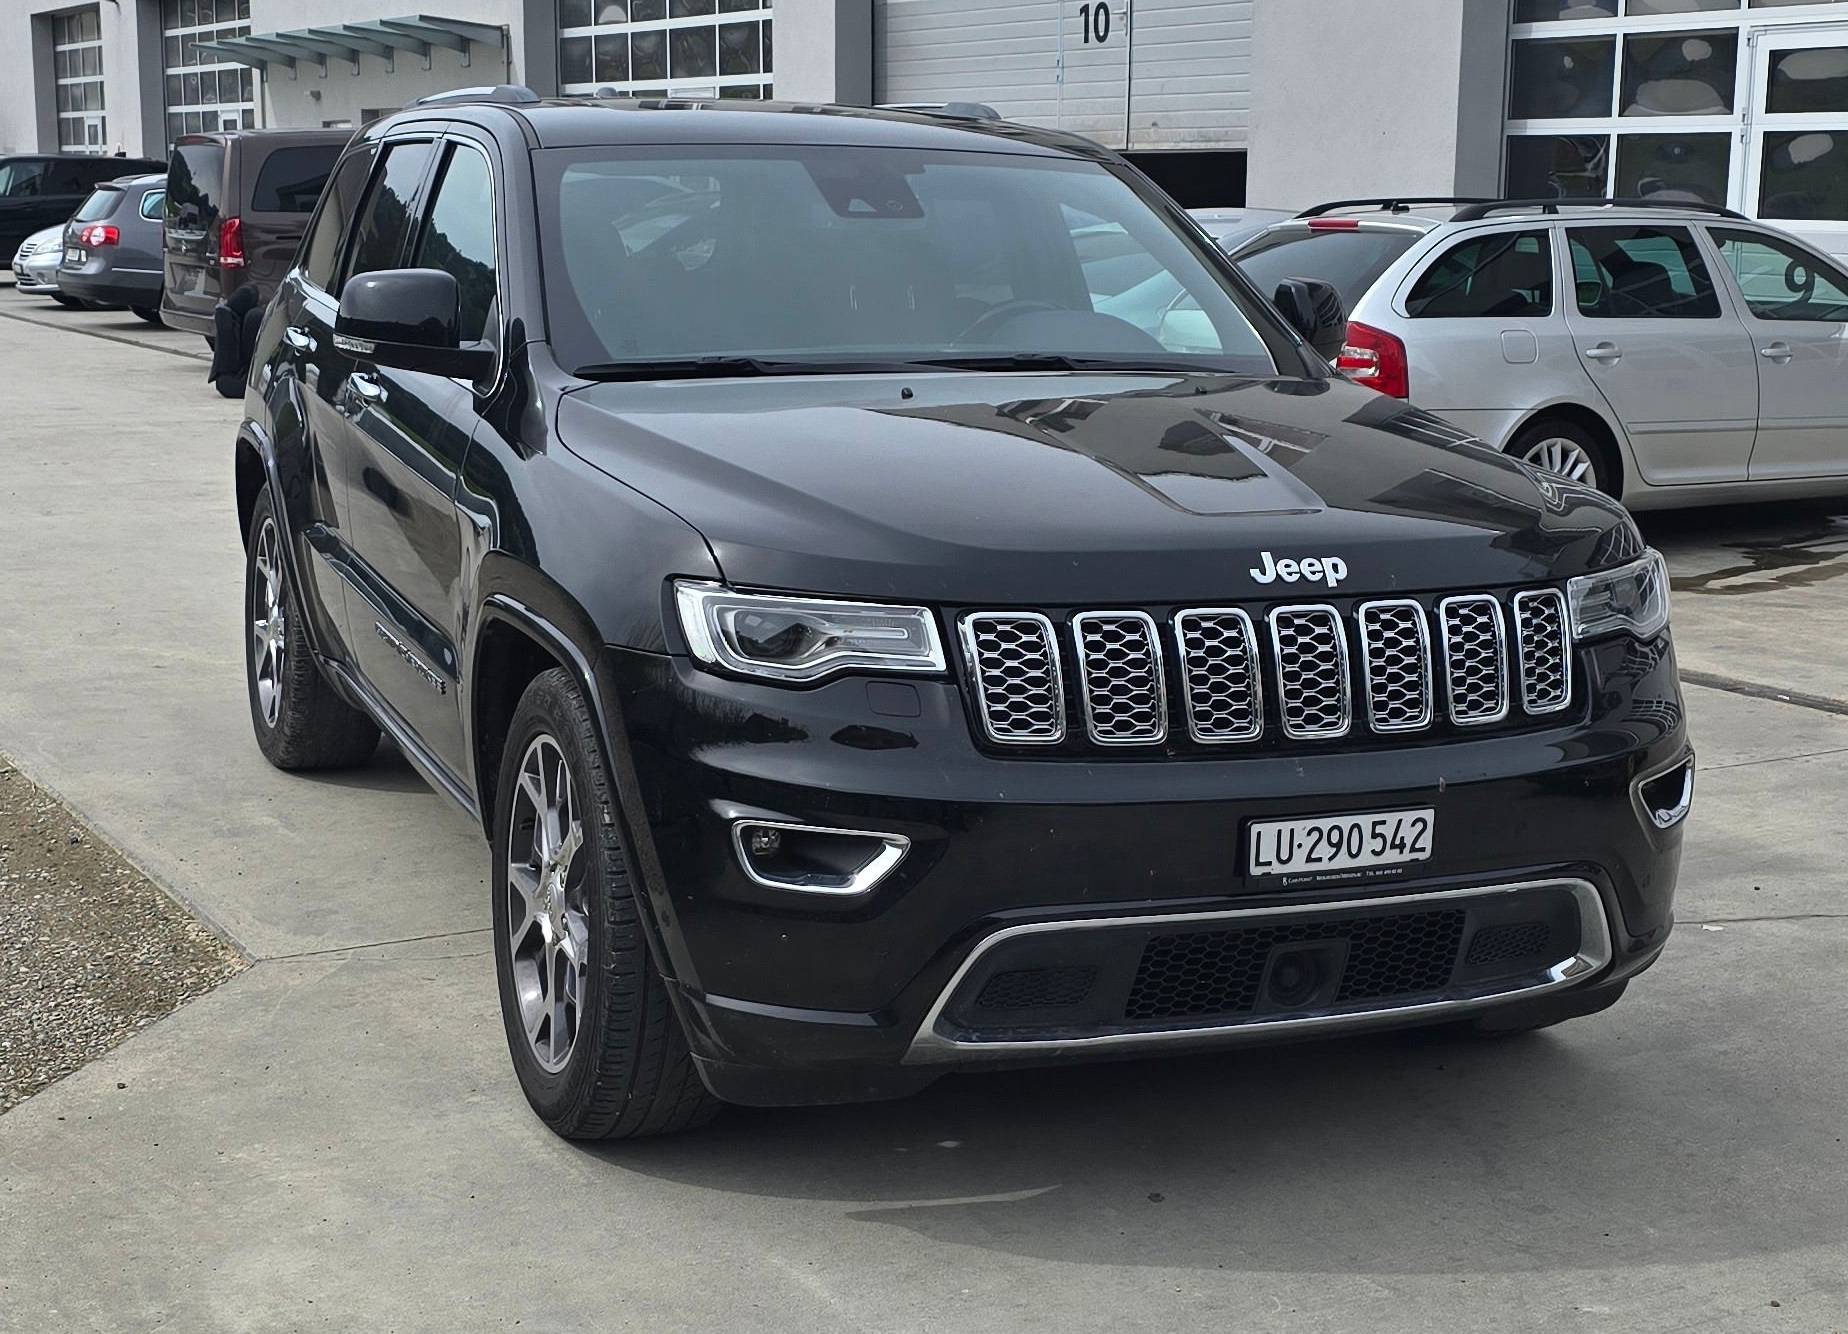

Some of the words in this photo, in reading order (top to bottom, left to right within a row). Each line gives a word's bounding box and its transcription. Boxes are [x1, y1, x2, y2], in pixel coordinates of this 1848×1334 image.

[1079, 1, 1110, 44] 10
[1784, 259, 1816, 305] 9
[1249, 551, 1348, 588] Jeep
